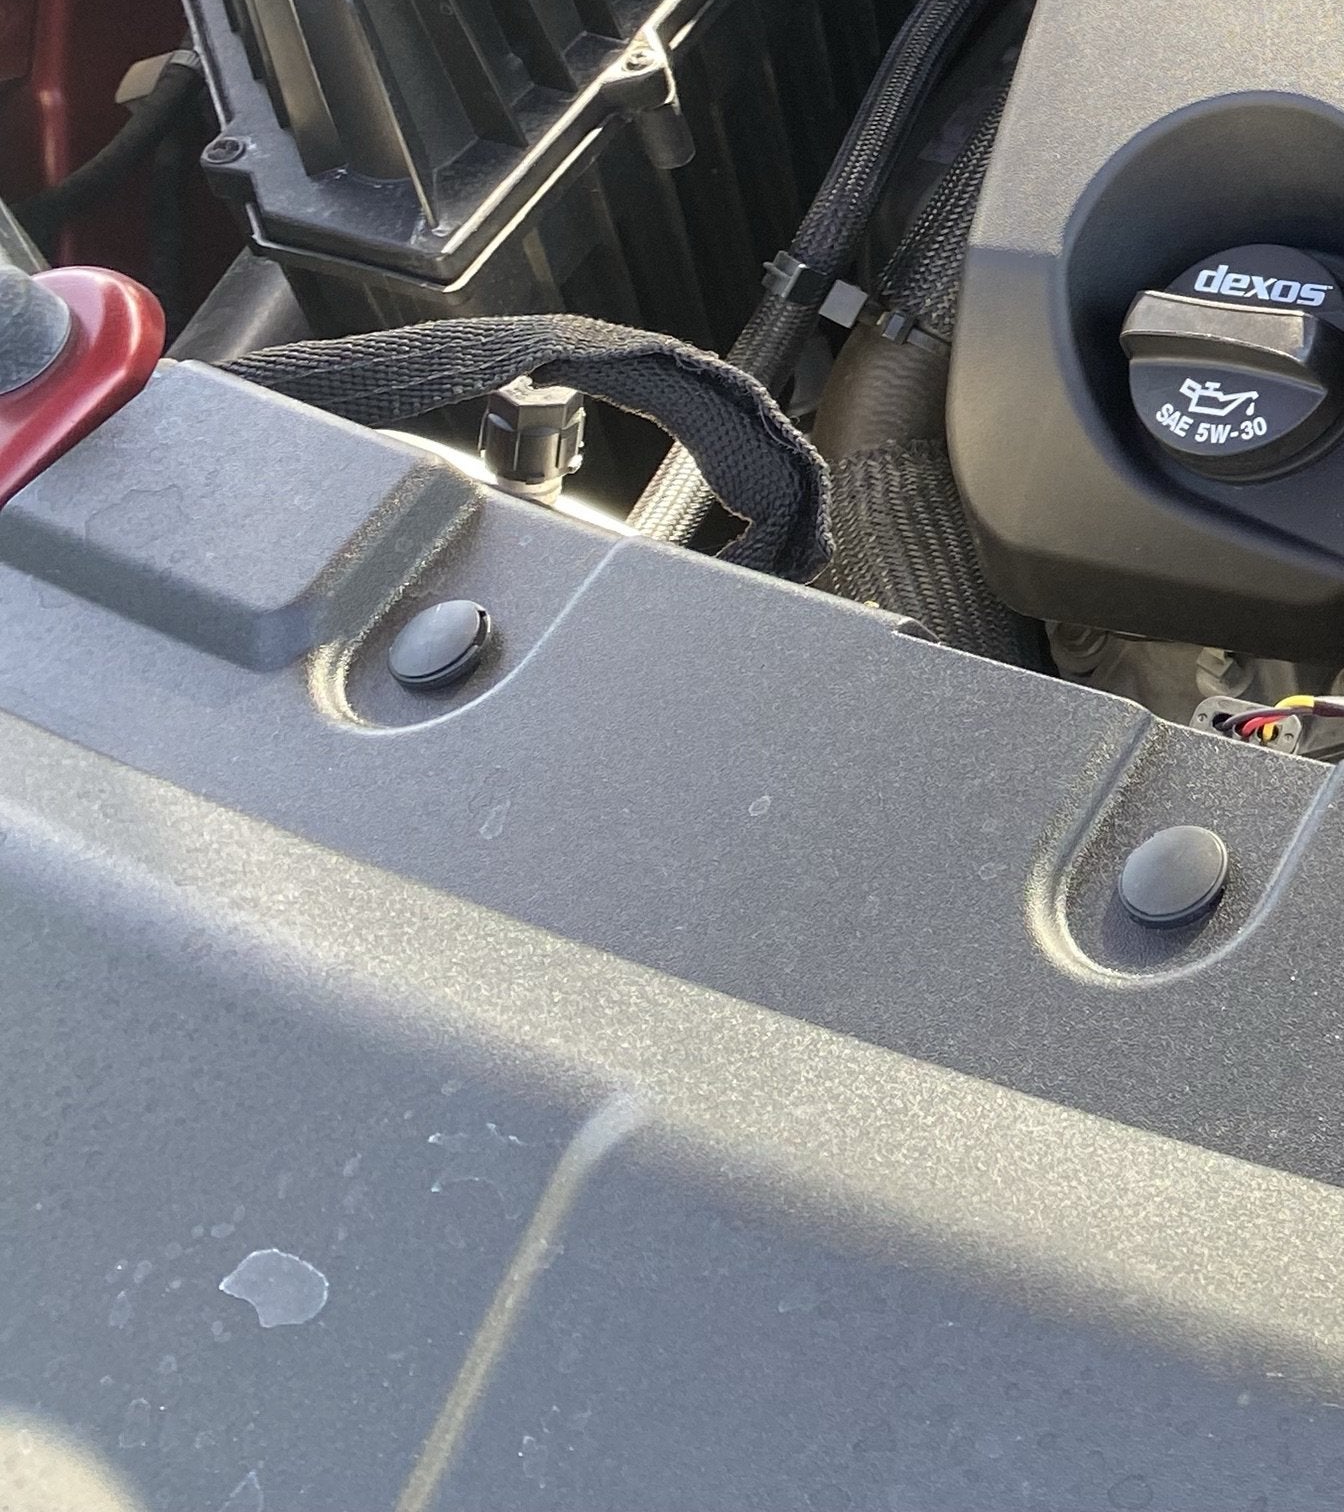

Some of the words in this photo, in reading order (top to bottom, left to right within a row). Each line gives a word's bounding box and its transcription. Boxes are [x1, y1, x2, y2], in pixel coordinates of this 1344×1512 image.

[1193, 264, 1329, 306] dexos
[1156, 403, 1194, 437] SAE
[1194, 416, 1268, 444] 5W-30
